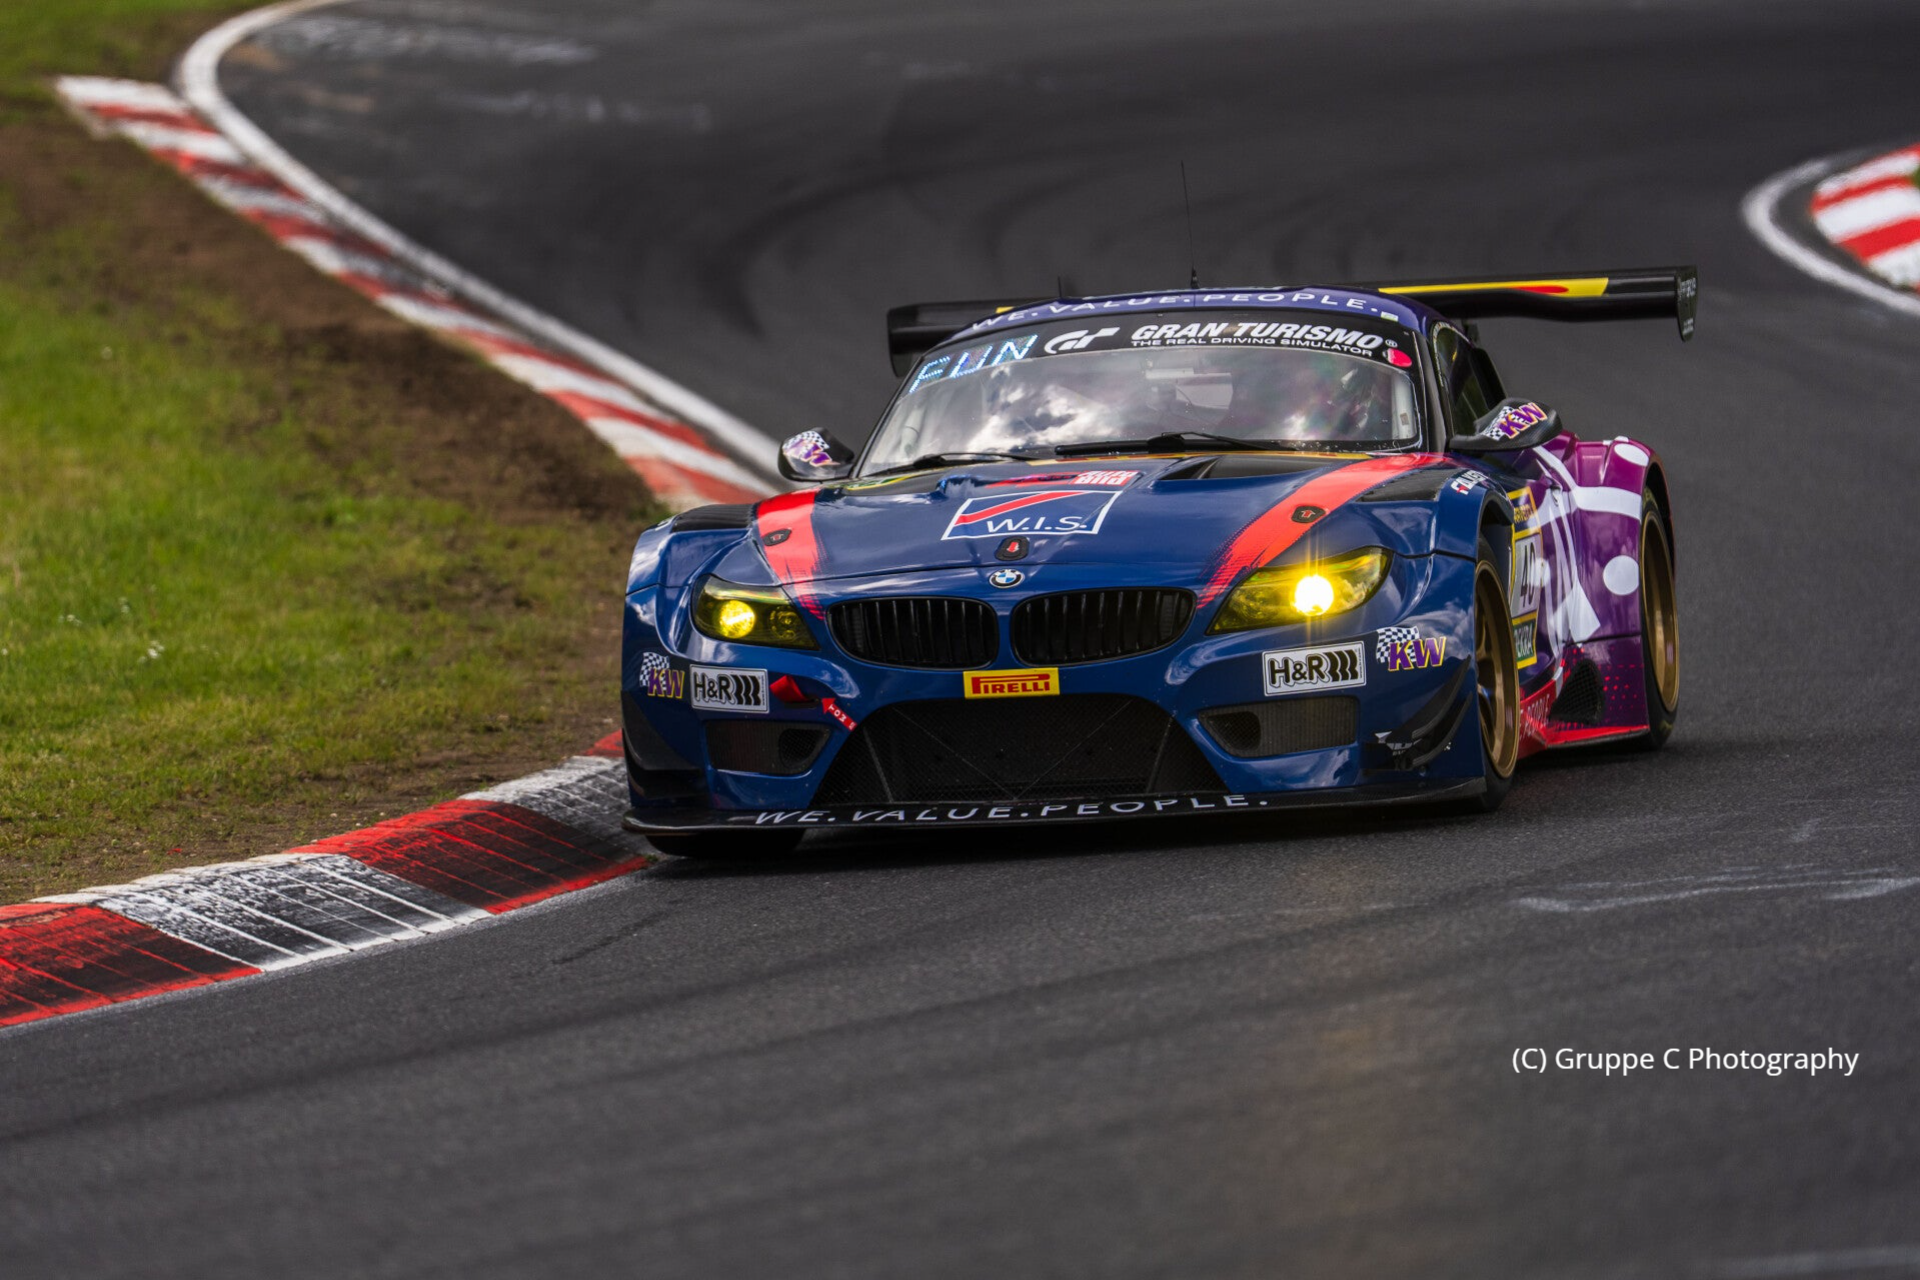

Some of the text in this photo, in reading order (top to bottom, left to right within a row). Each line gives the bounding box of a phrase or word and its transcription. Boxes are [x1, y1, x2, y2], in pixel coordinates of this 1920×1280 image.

[1131, 322, 1384, 349] GRAN TURISMO
[1166, 337, 1207, 345] REAL
[1211, 337, 1276, 345] DRIVING
[1280, 338, 1373, 357] SIMULATOR
[909, 333, 1039, 393] FUN
[1498, 402, 1548, 439] KW
[986, 516, 1088, 533] W.I.S.
[1387, 636, 1447, 673] KW
[647, 668, 686, 699] KW
[971, 673, 1051, 695] PIRELLI
[1268, 654, 1328, 688] H&R
[693, 671, 734, 703] H&R
